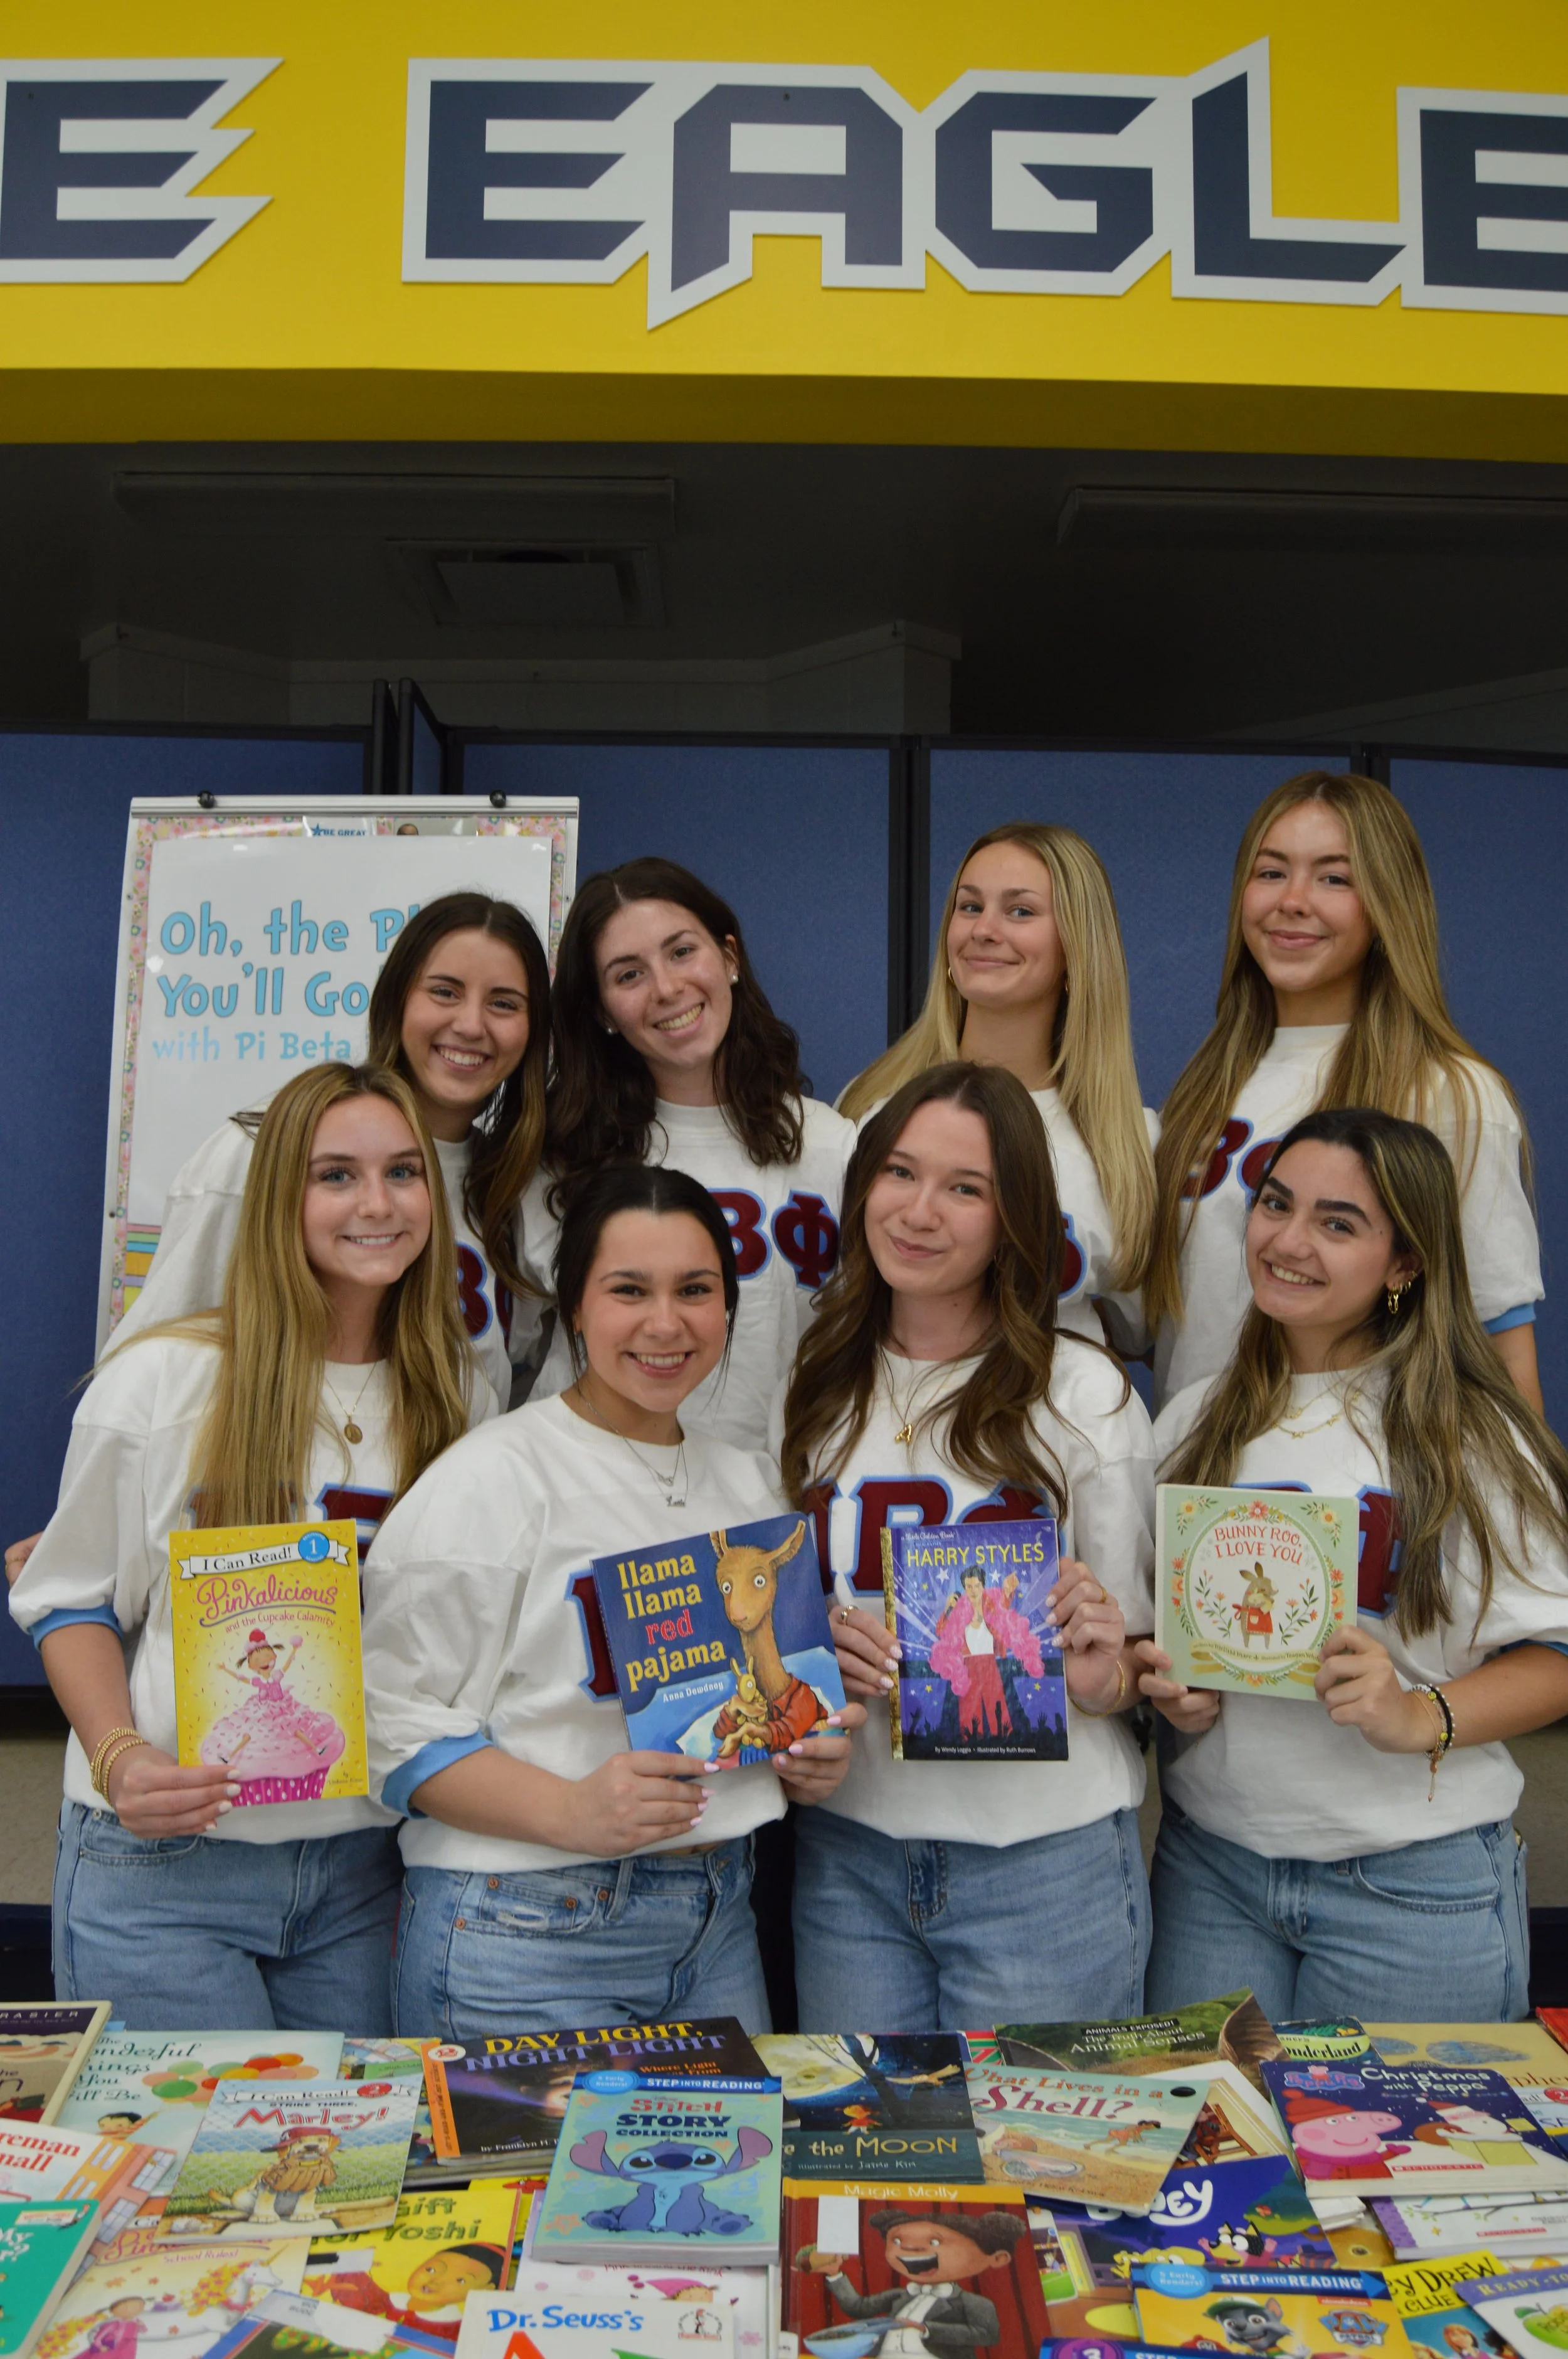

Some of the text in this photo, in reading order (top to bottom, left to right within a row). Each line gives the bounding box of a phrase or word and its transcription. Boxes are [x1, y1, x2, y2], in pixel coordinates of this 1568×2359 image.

[161, 901, 243, 957] Oh,
[263, 900, 349, 955] the
[157, 962, 369, 1018] You'll Go
[152, 1027, 351, 1062] with Pi Beta
[1214, 1525, 1268, 1542] BUNNY
[203, 1538, 317, 1571] I Can Read! 1
[907, 1543, 1044, 1567] HARRY STYLES
[1215, 1541, 1303, 1565] I LOVE YOU
[617, 1554, 697, 1590] llama
[197, 1574, 338, 1620] Pinkalicious
[622, 1583, 702, 1621] llama
[225, 1609, 336, 1633] and the Cupcake Calamity
[645, 1609, 694, 1645] red
[625, 1640, 727, 1693] pajama
[662, 1681, 724, 1703] Anna Dewdney
[1082, 2027, 1183, 2044] The Truth About
[1130, 2019, 1175, 2032] EXPOSED!
[485, 2032, 560, 2055] DAY
[575, 2022, 702, 2045] LIGHT,
[1071, 2031, 1205, 2053] Animal Senses
[465, 2045, 593, 2071] NIGHT
[607, 2035, 726, 2057] LIGHT
[647, 2078, 680, 2088] STEP
[702, 2080, 762, 2090] READING
[1360, 2067, 1491, 2081] Christmas
[71, 2090, 102, 2101] ill
[303, 2089, 349, 2099] Read!
[1038, 2077, 1104, 2094] Lives
[1115, 2084, 1140, 2097] in
[1148, 2090, 1163, 2099] a
[1417, 2080, 1487, 2094] Peppa
[970, 2084, 1134, 2119] Shell?
[234, 2107, 389, 2131] Marley!
[617, 2114, 733, 2127] STORY
[616, 2129, 728, 2138] COLLECTION
[809, 2140, 844, 2157] the
[856, 2137, 957, 2158] MOON
[859, 2160, 889, 2170] Jaime
[896, 2160, 916, 2170] Kim
[844, 2183, 958, 2201] Magic Molly
[383, 2219, 482, 2242] Yoshi
[164, 2248, 240, 2264] School Rules!
[1159, 2277, 1202, 2287] Readers!
[1169, 2272, 1195, 2281] Early
[1221, 2273, 1362, 2289] STEP INTO READING
[1414, 2257, 1496, 2292] DREW
[1476, 2277, 1540, 2296] READY
[1404, 2293, 1456, 2313] CLUE
[487, 2304, 644, 2332] Dr. Seuss's
